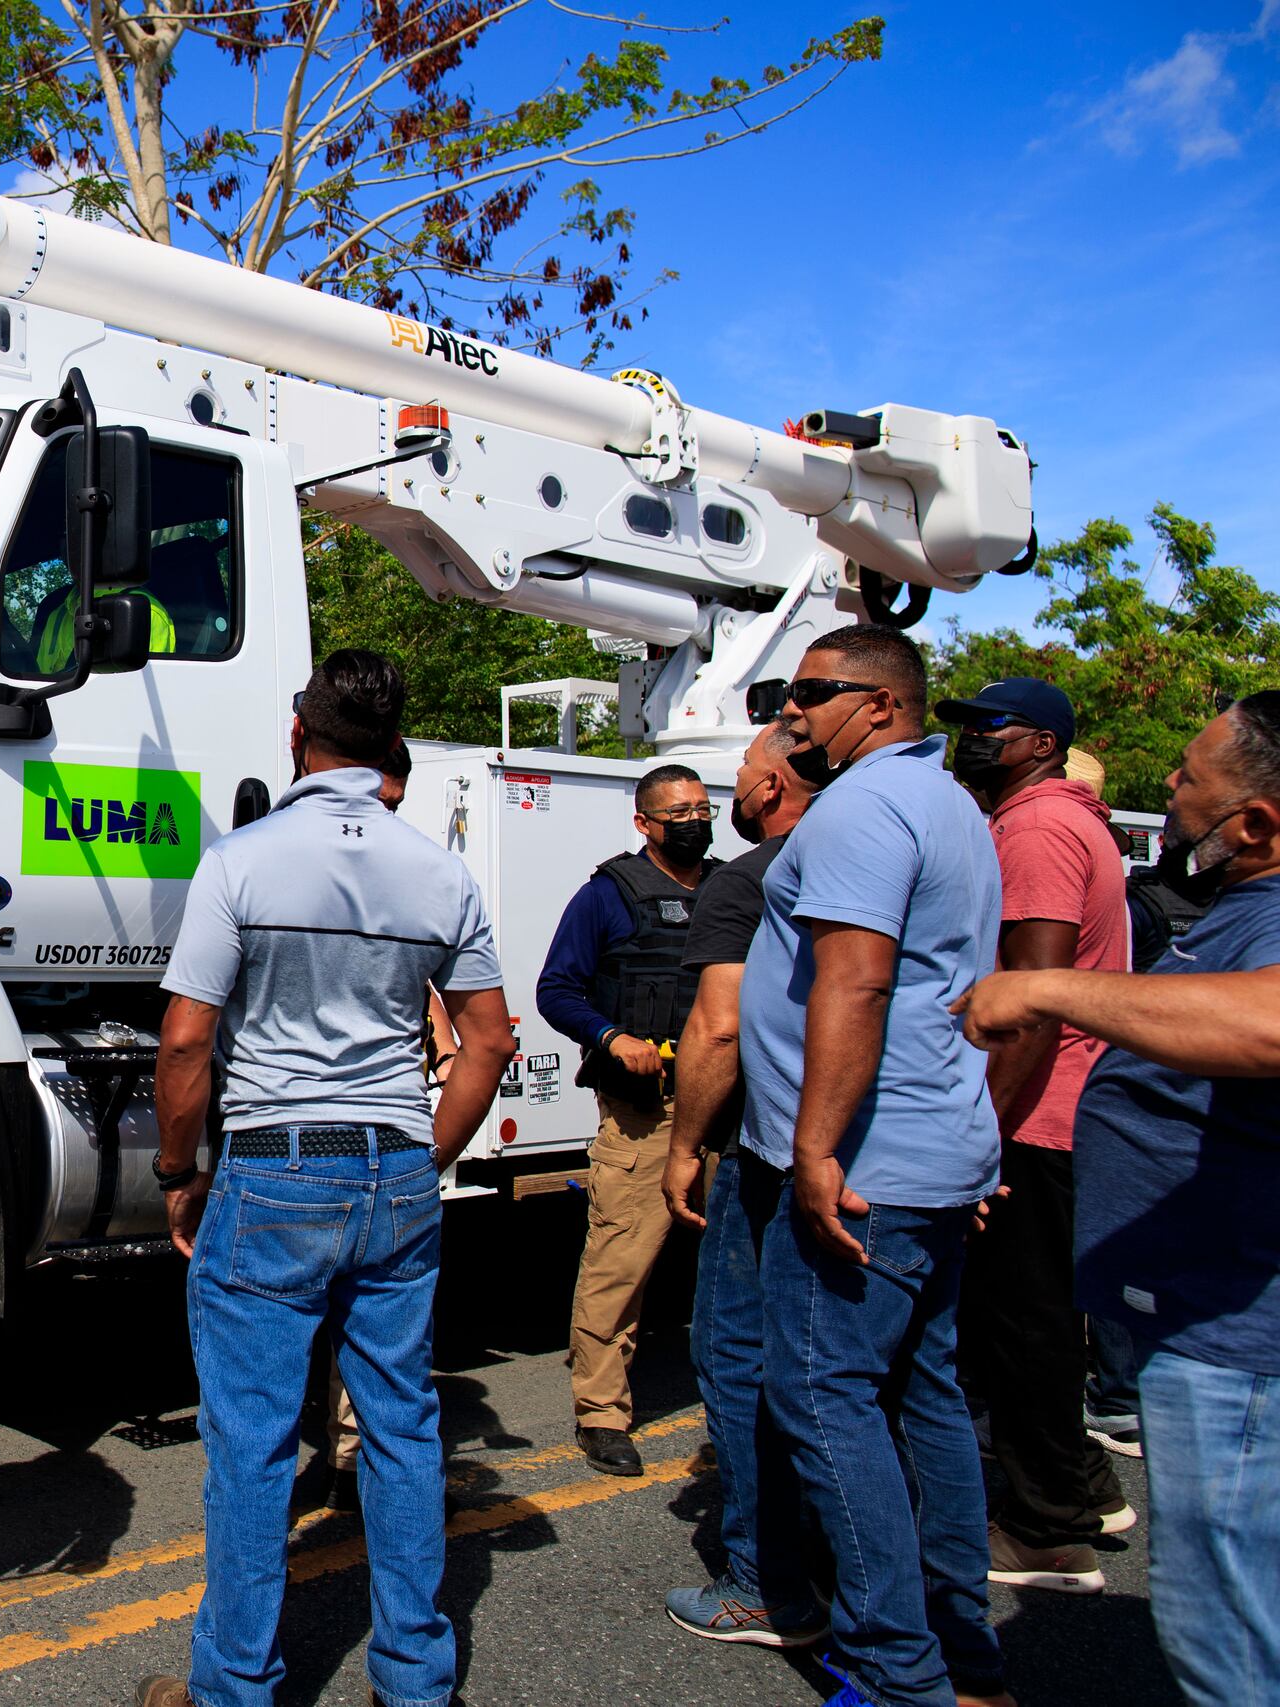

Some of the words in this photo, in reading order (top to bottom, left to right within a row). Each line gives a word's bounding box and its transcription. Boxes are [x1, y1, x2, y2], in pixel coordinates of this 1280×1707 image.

[425, 327, 499, 376] Altec
[44, 797, 181, 845] LUMA
[35, 944, 104, 965] USDOT
[530, 1054, 558, 1071] TARA
